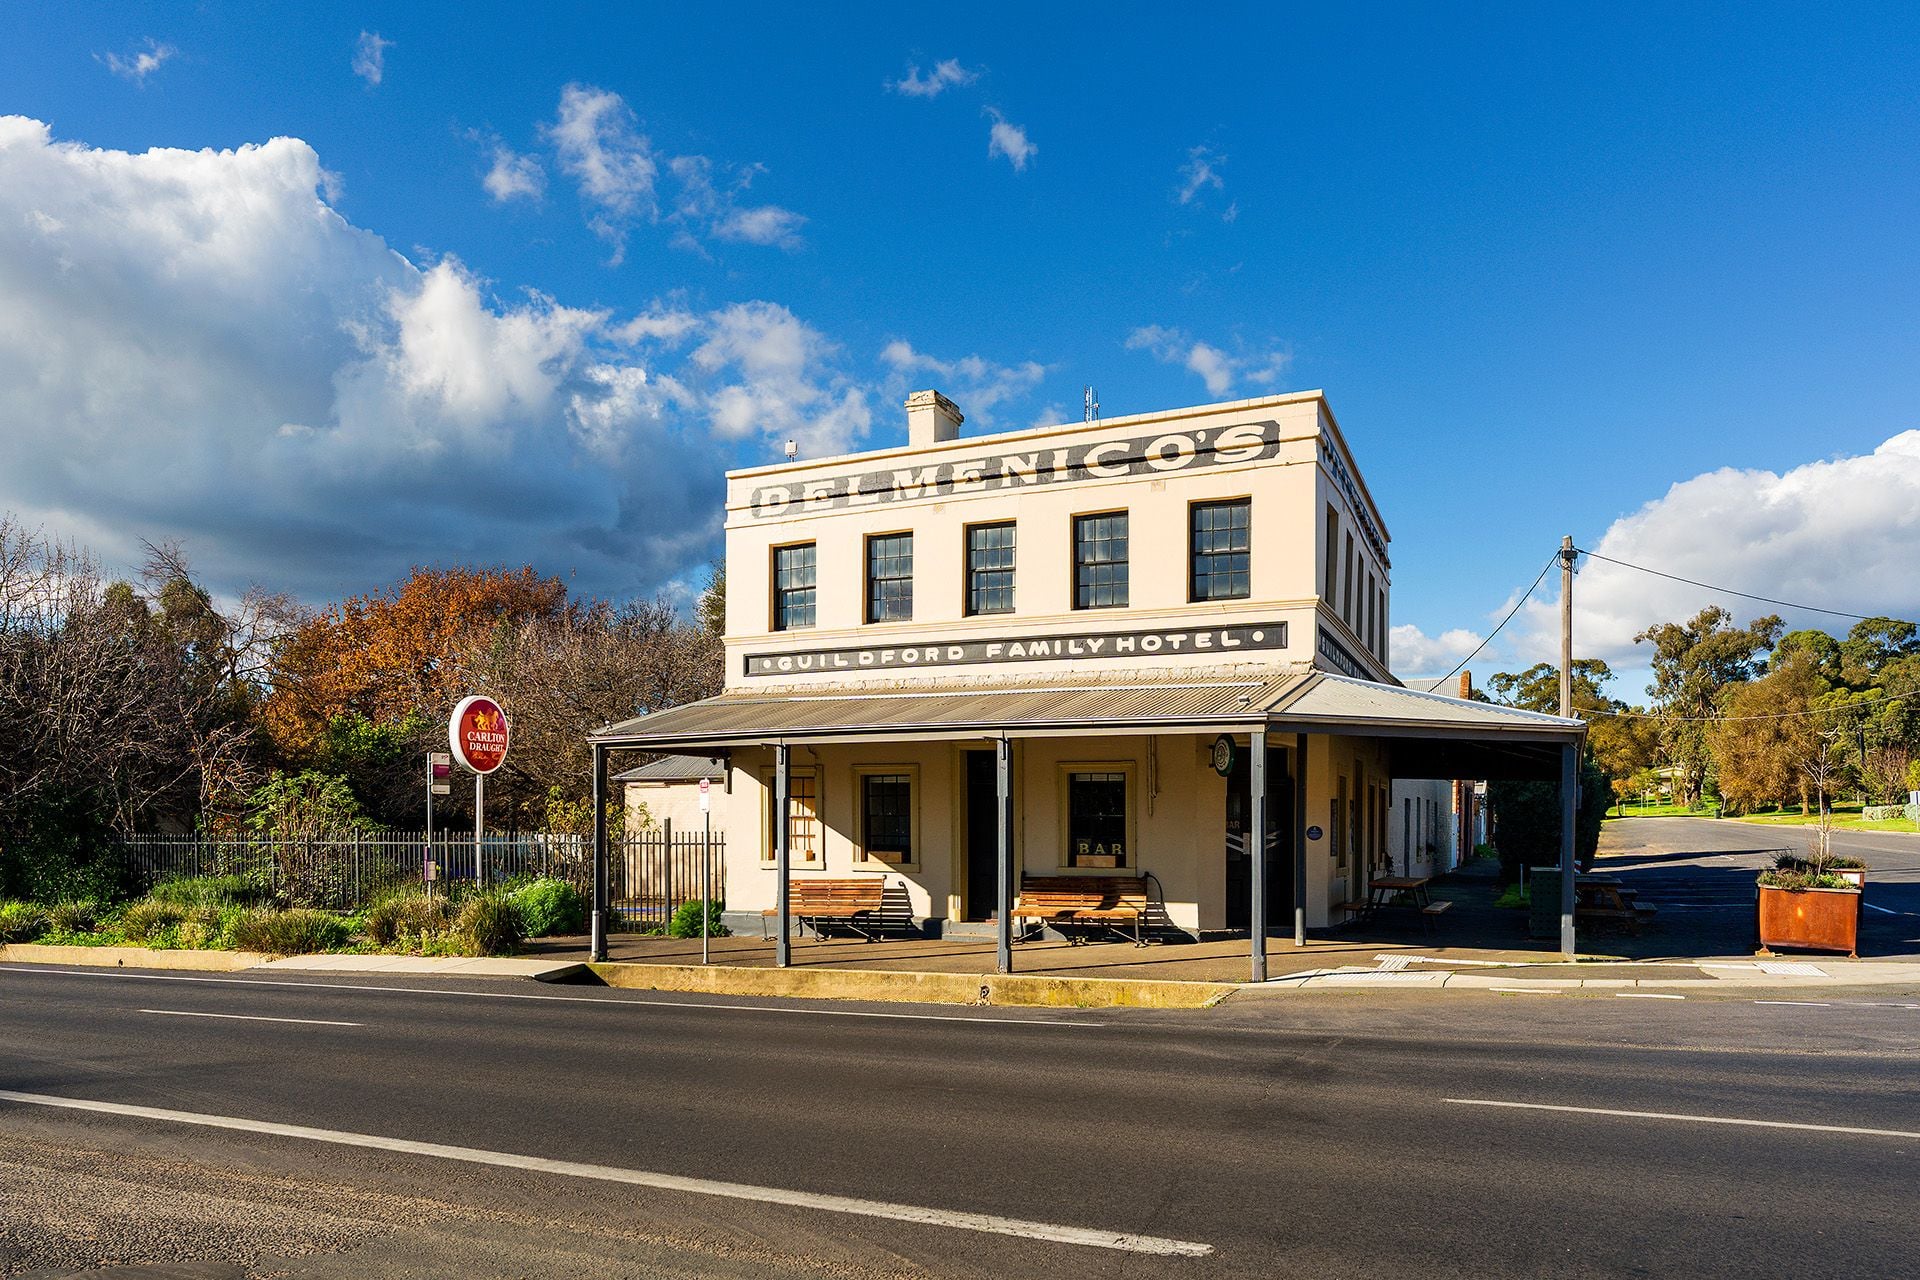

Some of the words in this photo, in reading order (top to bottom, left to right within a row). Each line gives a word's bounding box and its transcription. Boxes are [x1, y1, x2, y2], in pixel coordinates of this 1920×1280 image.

[757, 423, 1267, 518] DELMENICO'S
[777, 645, 964, 671] GUILDFORD
[986, 637, 1105, 658] FAMILY
[1116, 630, 1241, 652] HOTEL
[467, 731, 506, 743] CARLTON
[470, 742, 504, 752] DRAUGHT
[1079, 843, 1123, 855] BAR
